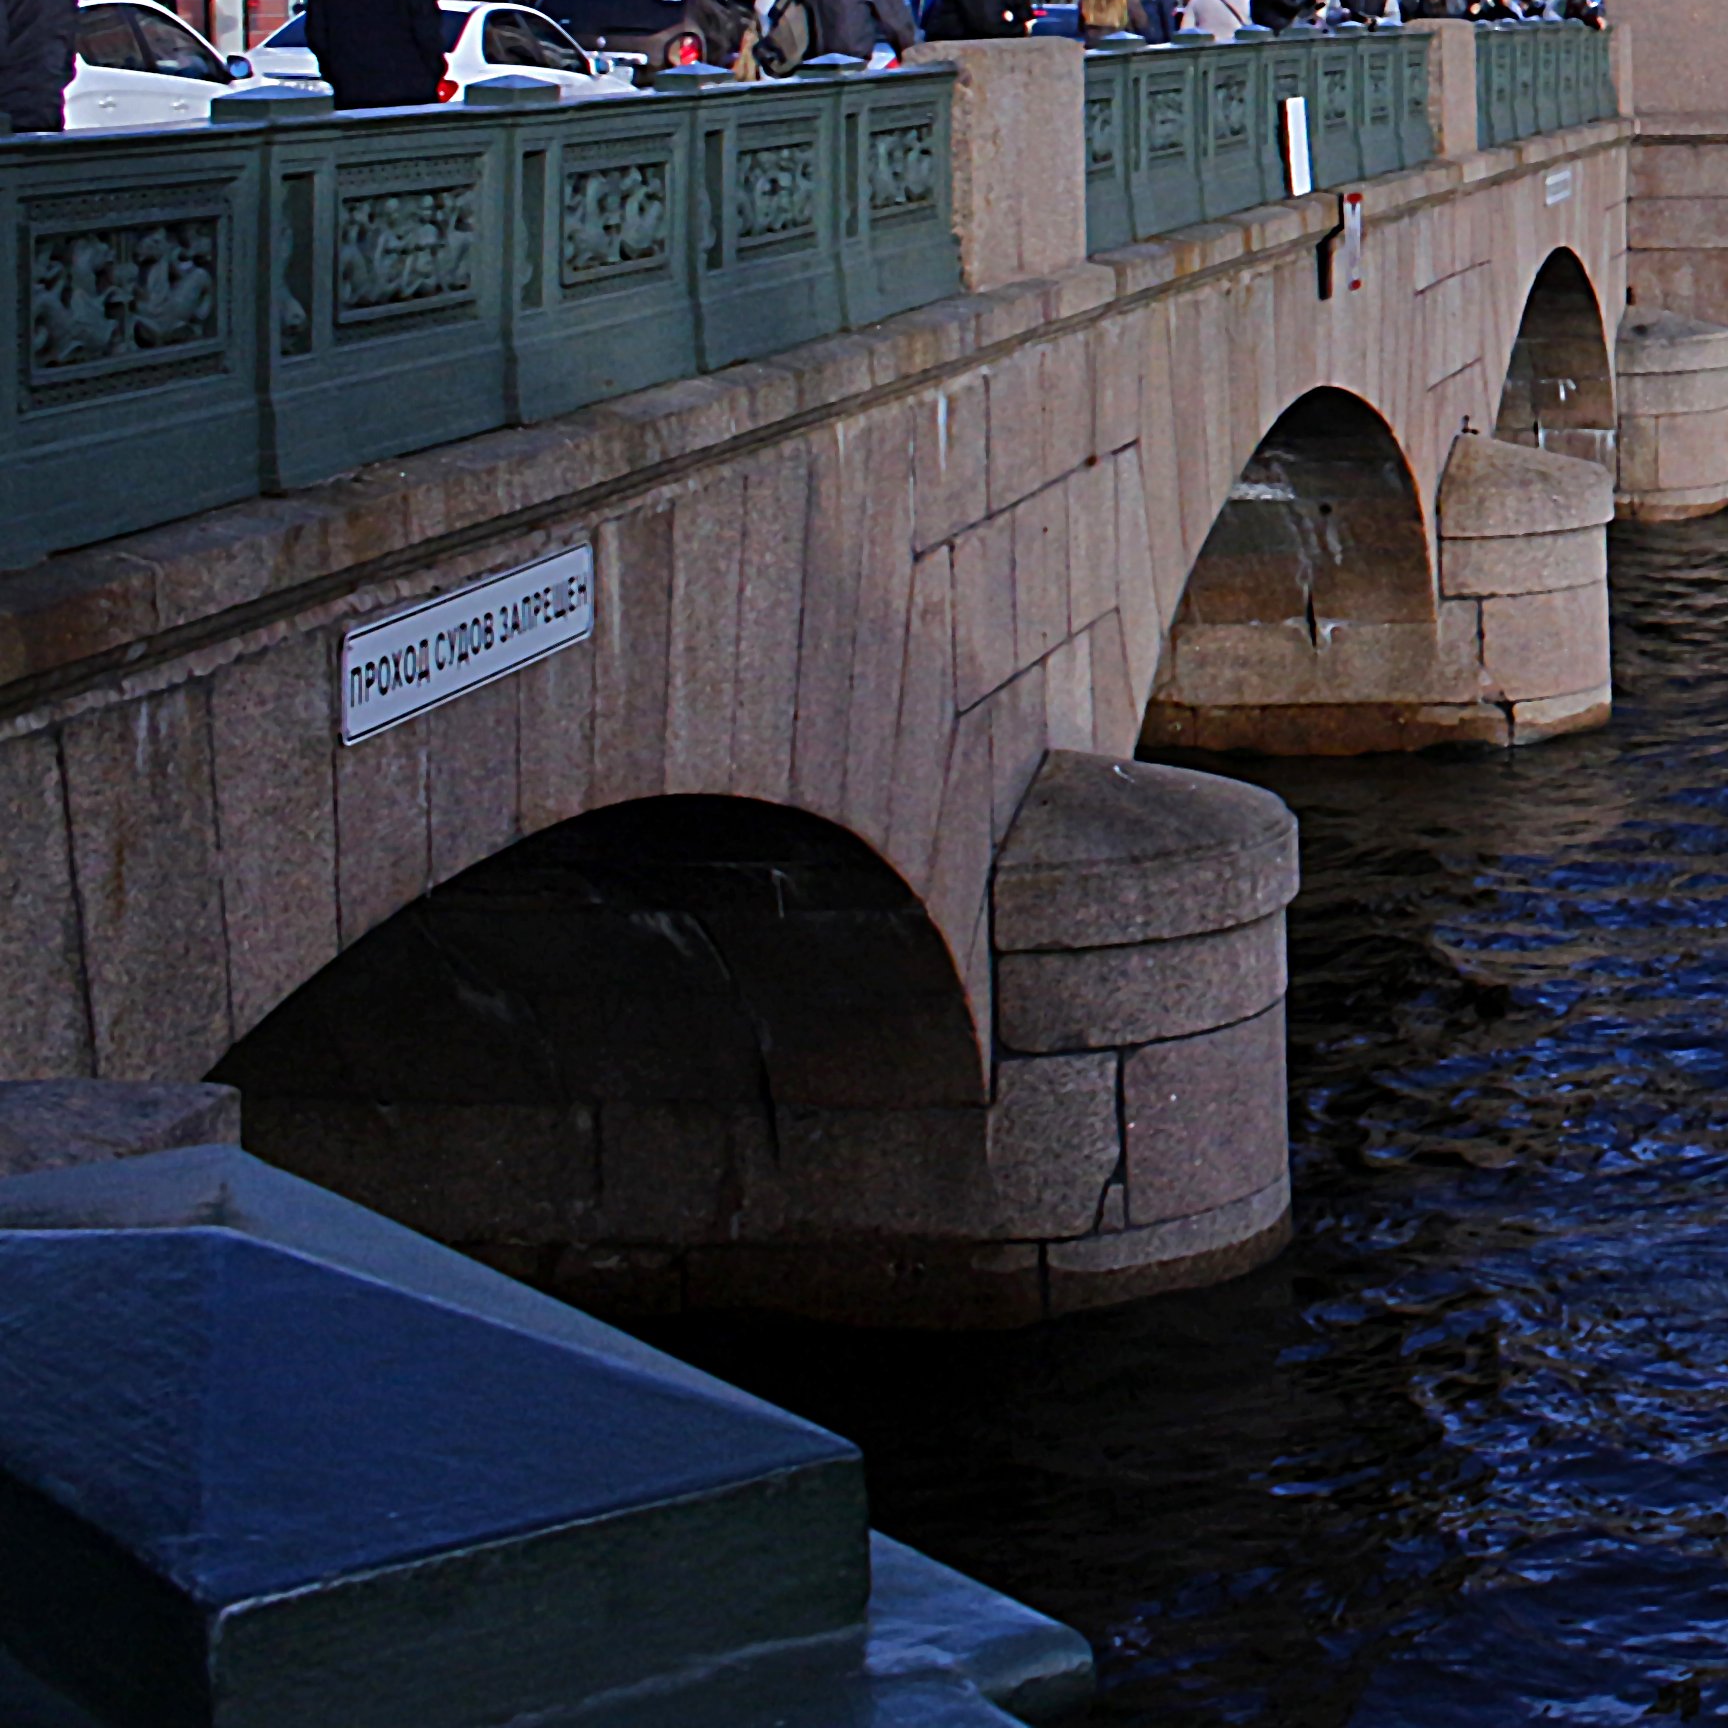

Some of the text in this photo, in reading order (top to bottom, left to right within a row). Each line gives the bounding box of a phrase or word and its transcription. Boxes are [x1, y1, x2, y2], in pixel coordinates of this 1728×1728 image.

[350, 575, 588, 707] ПРОХОД СУДОВ ЗАПРЕЩЕН
